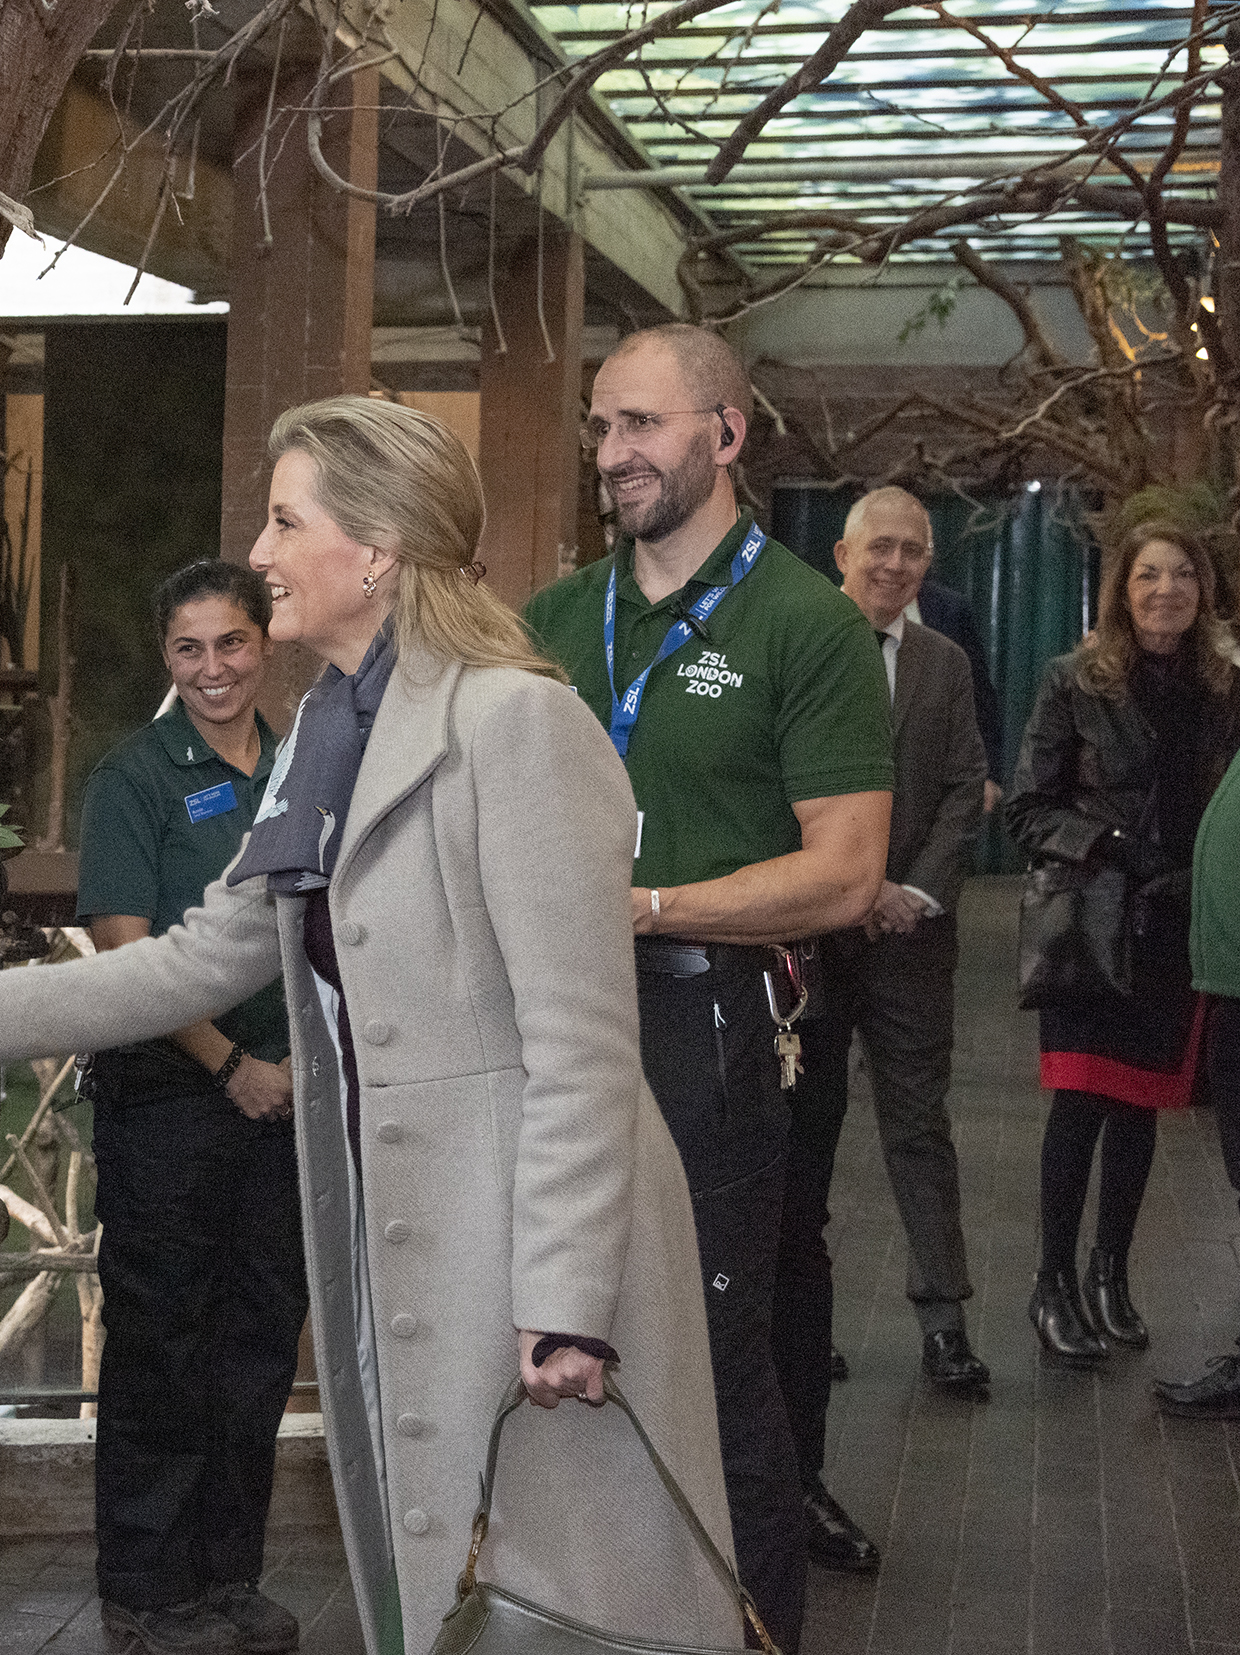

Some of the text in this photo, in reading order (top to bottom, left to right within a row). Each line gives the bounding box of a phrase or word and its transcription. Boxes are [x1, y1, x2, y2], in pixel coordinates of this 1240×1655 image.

[741, 540, 761, 563] ZSL
[704, 599, 715, 611] FOR
[697, 650, 729, 669] ZSL
[676, 663, 744, 688] LONDON
[685, 679, 723, 699] ZOO
[623, 687, 640, 715] ZSL
